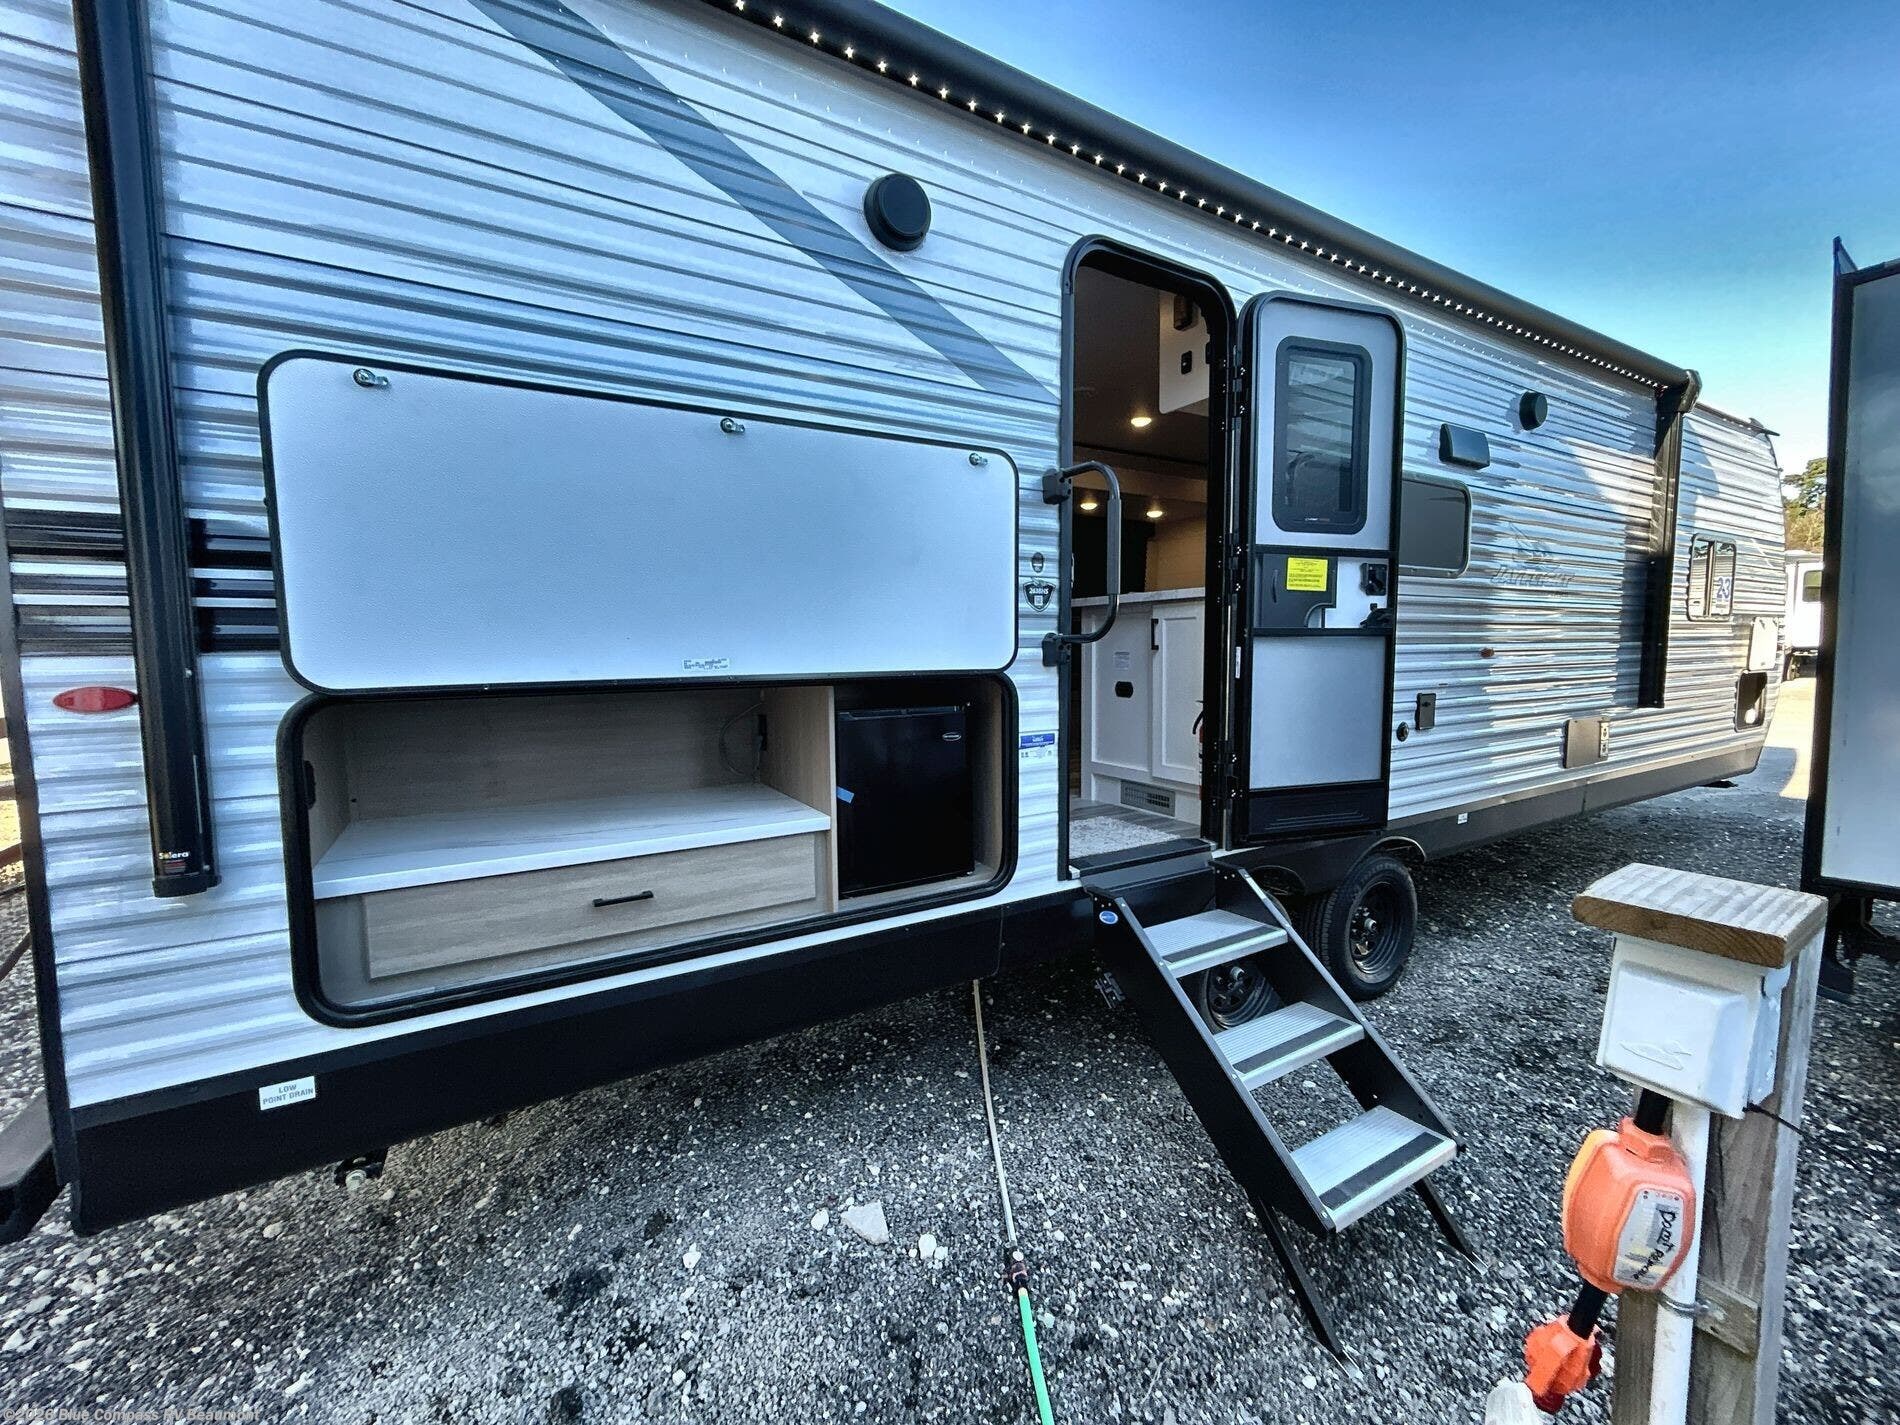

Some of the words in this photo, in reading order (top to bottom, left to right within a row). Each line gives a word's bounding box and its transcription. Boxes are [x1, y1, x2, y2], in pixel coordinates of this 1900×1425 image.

[278, 1084, 297, 1094] LOW
[262, 1093, 287, 1105] POINT
[289, 1088, 314, 1099] DRAIN
